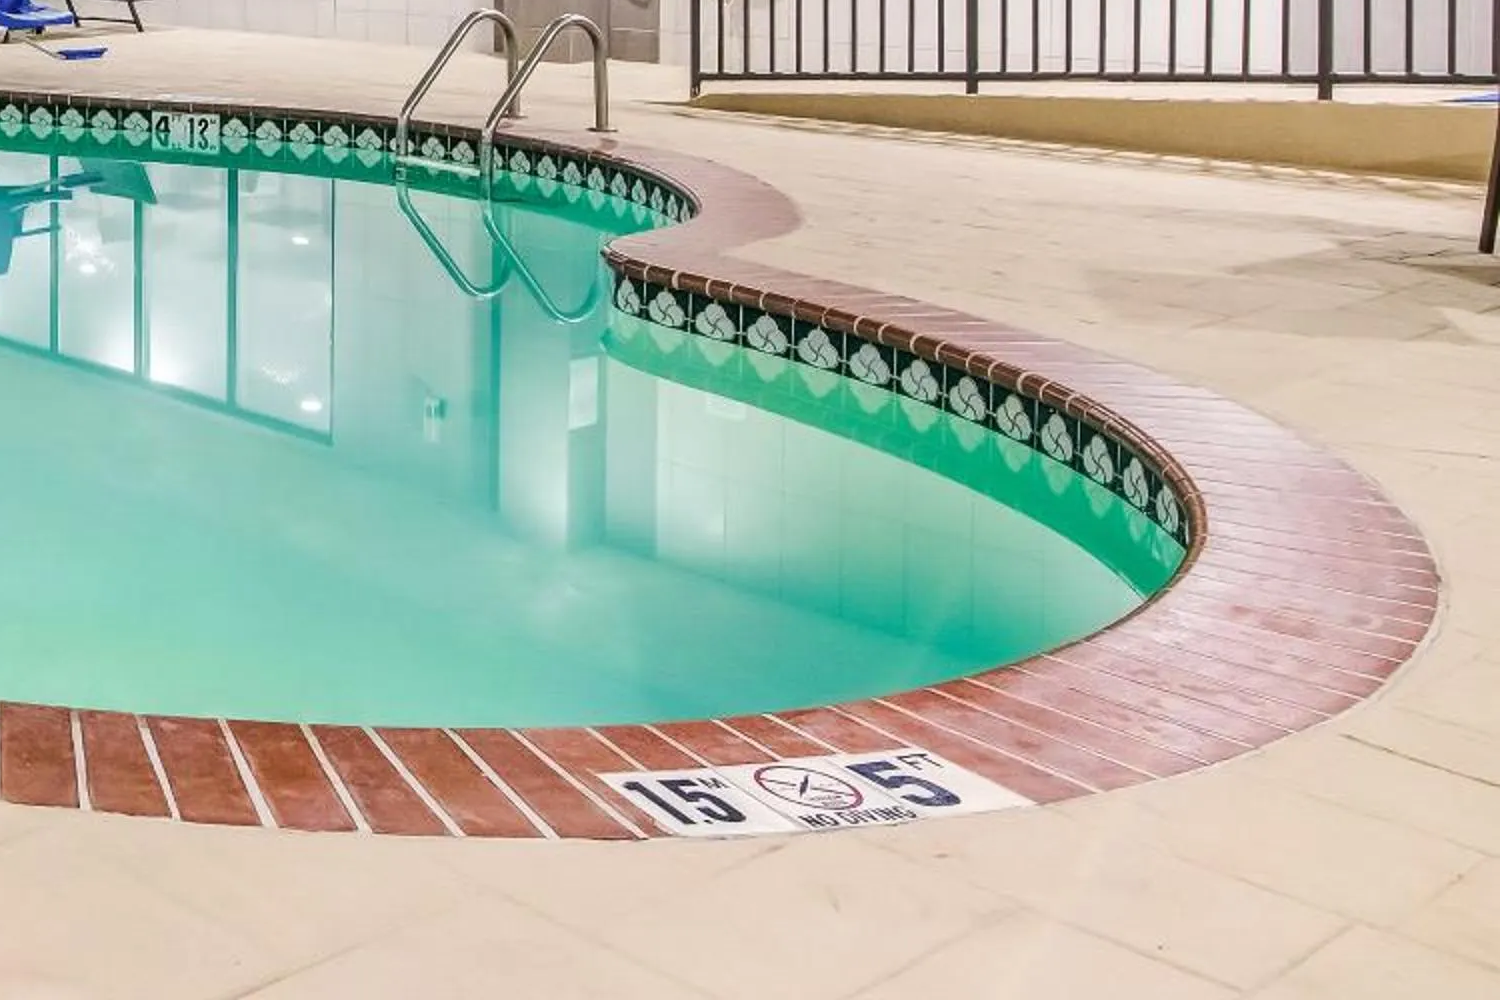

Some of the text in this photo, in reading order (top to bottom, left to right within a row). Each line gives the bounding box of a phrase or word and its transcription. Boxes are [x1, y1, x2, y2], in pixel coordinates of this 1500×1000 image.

[845, 753, 962, 807] 5 FT
[798, 805, 917, 828] NO DIVING
